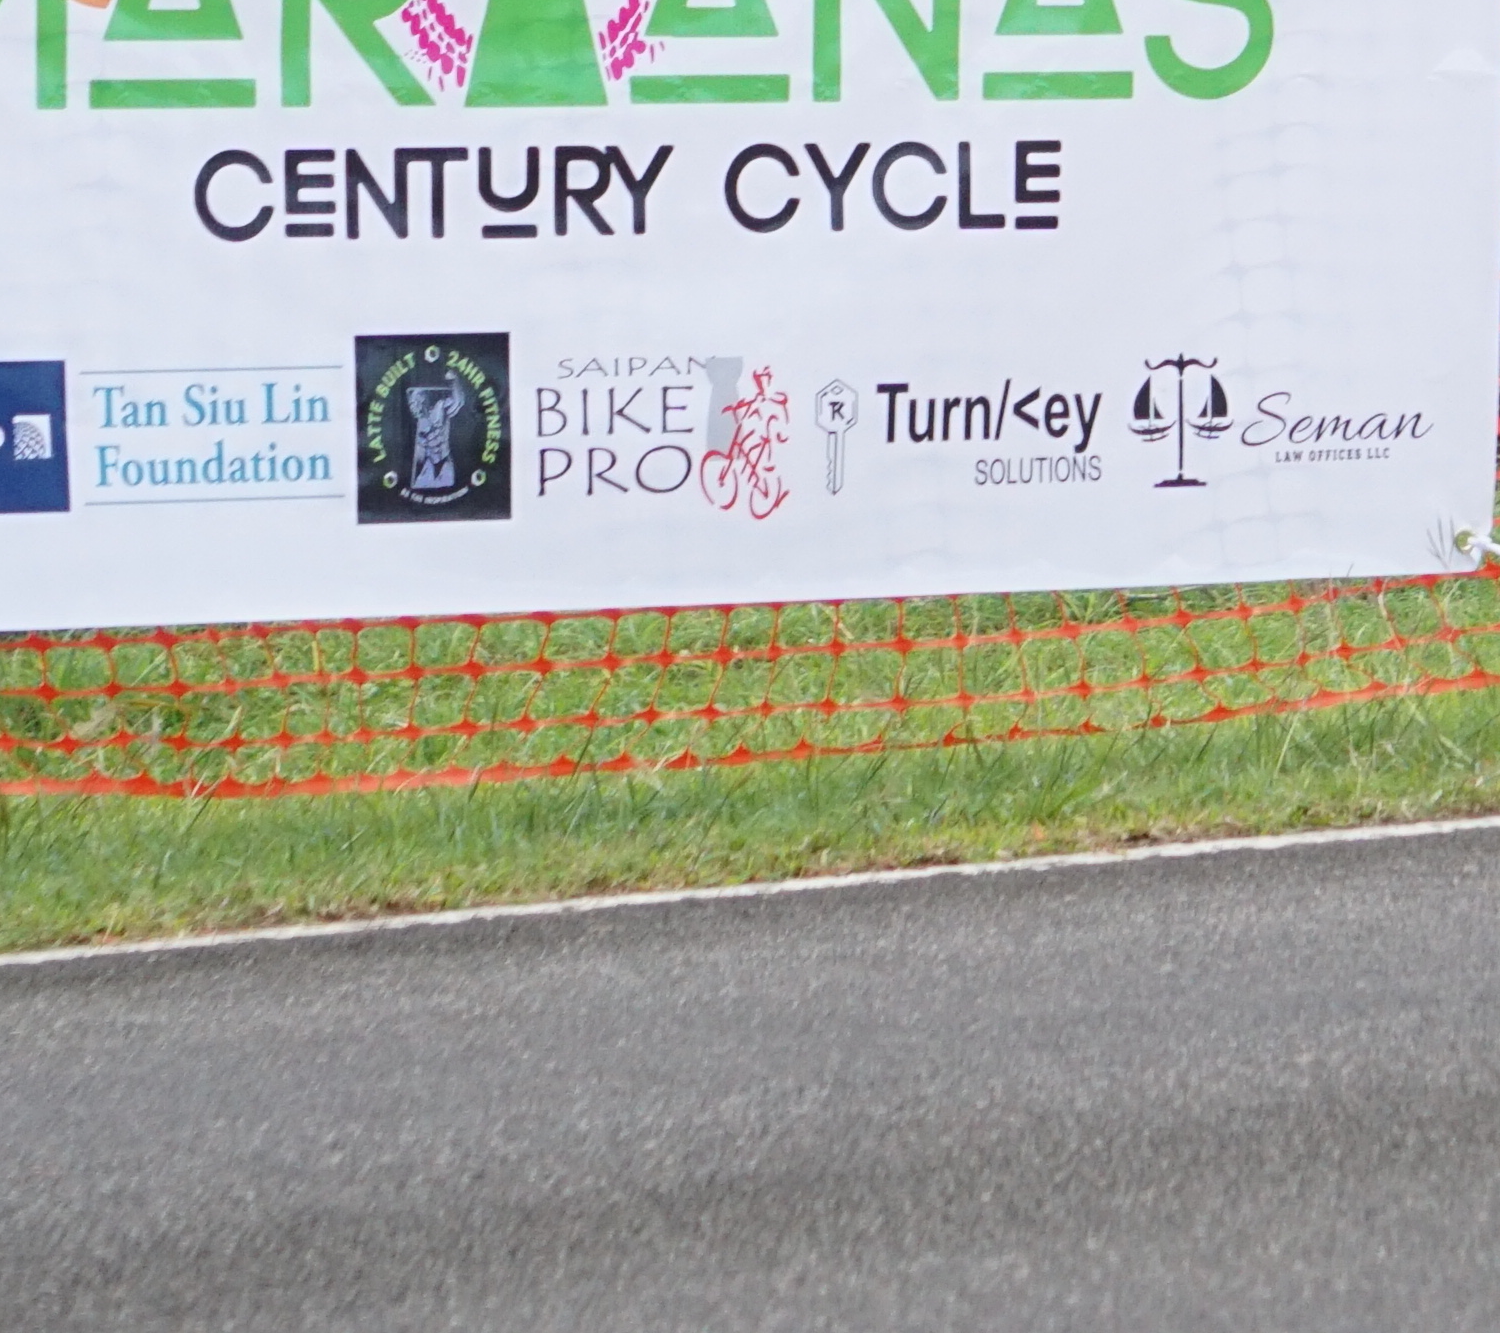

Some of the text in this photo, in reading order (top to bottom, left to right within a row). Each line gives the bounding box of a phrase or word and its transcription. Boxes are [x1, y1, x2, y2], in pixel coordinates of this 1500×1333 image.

[193, 139, 1063, 243] CENTURY CYCLE
[92, 381, 331, 429] Tan Siu Lin
[367, 399, 387, 463] LATTE
[536, 385, 694, 437] BIKE
[1240, 391, 1433, 447] Seman
[94, 439, 333, 488] Foundation
[537, 444, 694, 497] PRO
[975, 455, 1103, 486] SOLUTIONS
[1275, 446, 1390, 463] LAW OFFICES LLC
